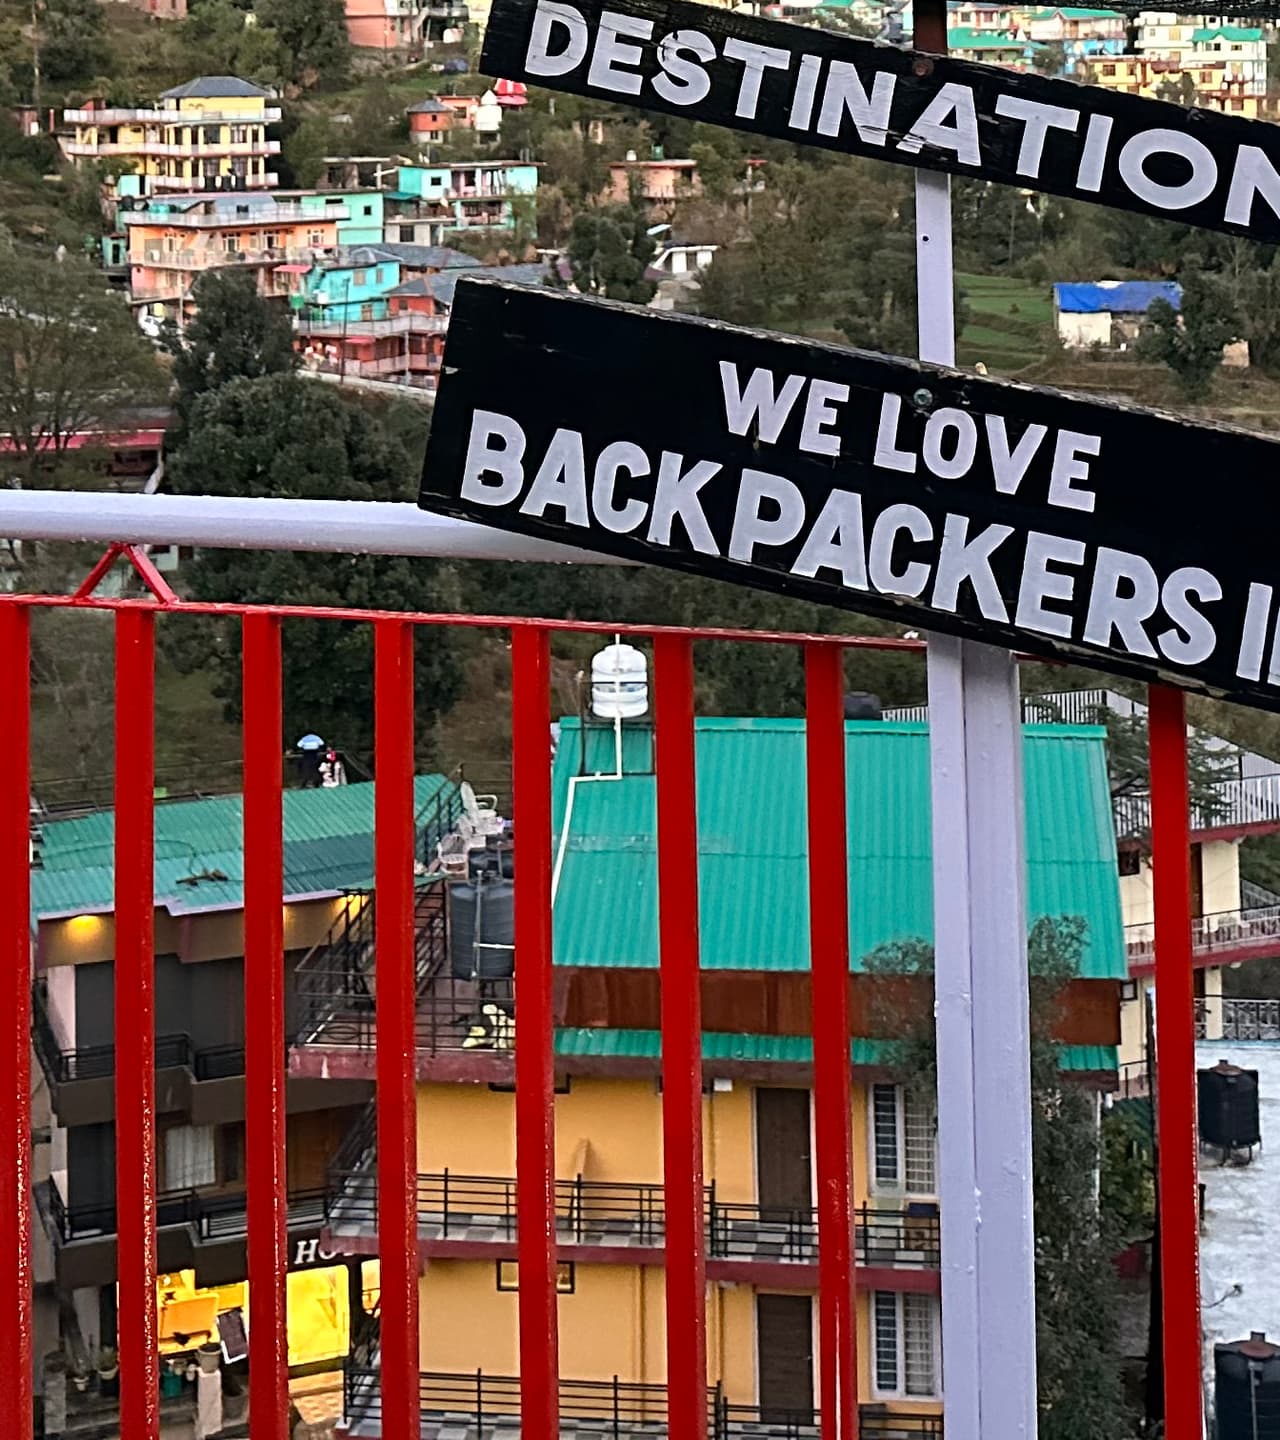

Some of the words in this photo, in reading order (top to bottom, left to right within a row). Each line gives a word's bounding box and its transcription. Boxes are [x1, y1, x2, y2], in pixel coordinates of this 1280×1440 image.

[459, 408, 1224, 666] BACKPACKERS
[718, 361, 851, 457] WE
[872, 392, 1102, 513] LOVE
